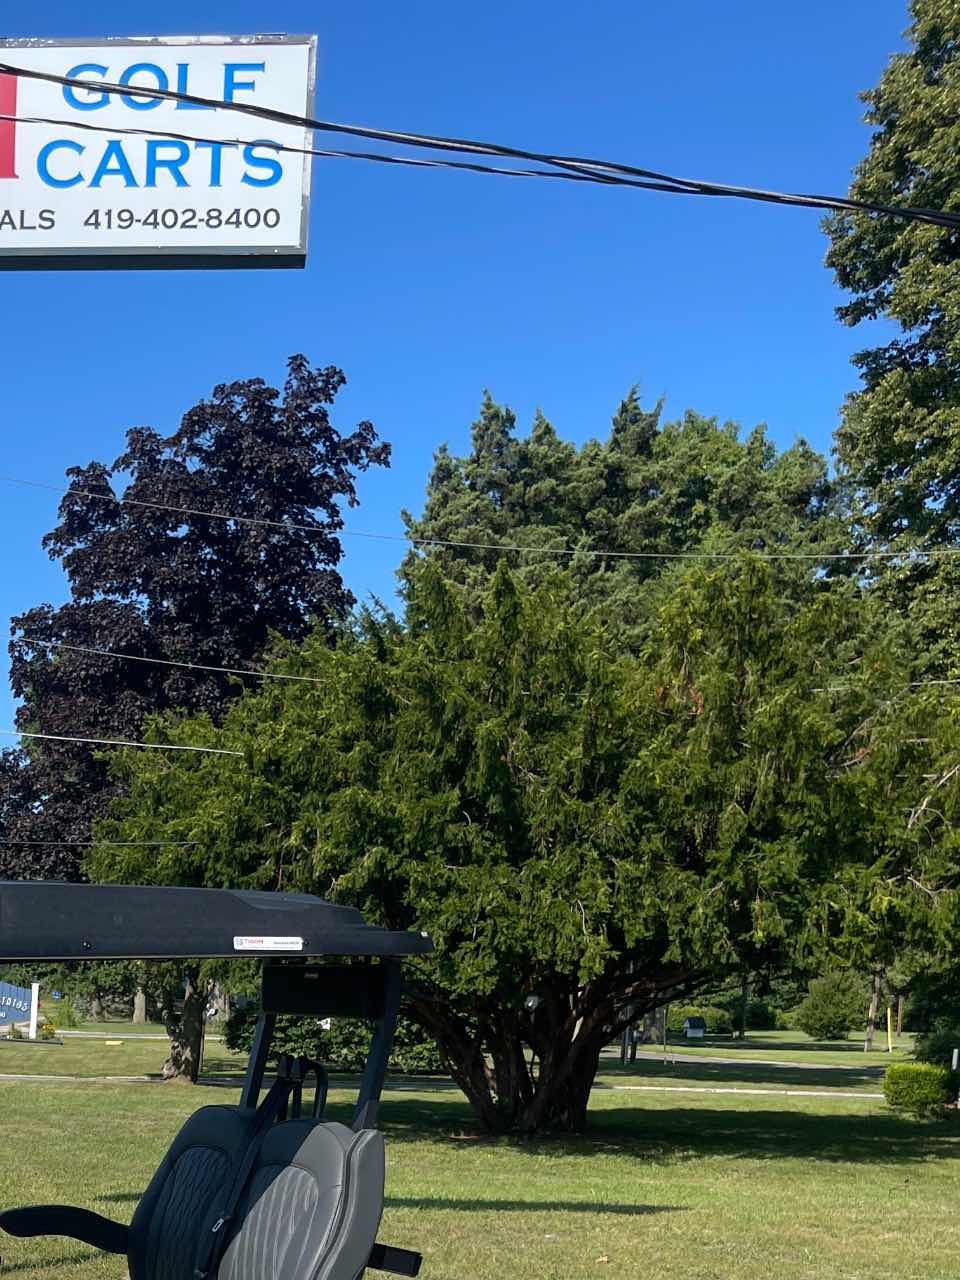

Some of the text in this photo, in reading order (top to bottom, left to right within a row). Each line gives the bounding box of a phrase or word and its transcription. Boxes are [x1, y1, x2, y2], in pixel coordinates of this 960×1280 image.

[62, 61, 266, 112] GOLF
[36, 139, 284, 188] CARTS
[83, 208, 280, 230] 419-402-8400
